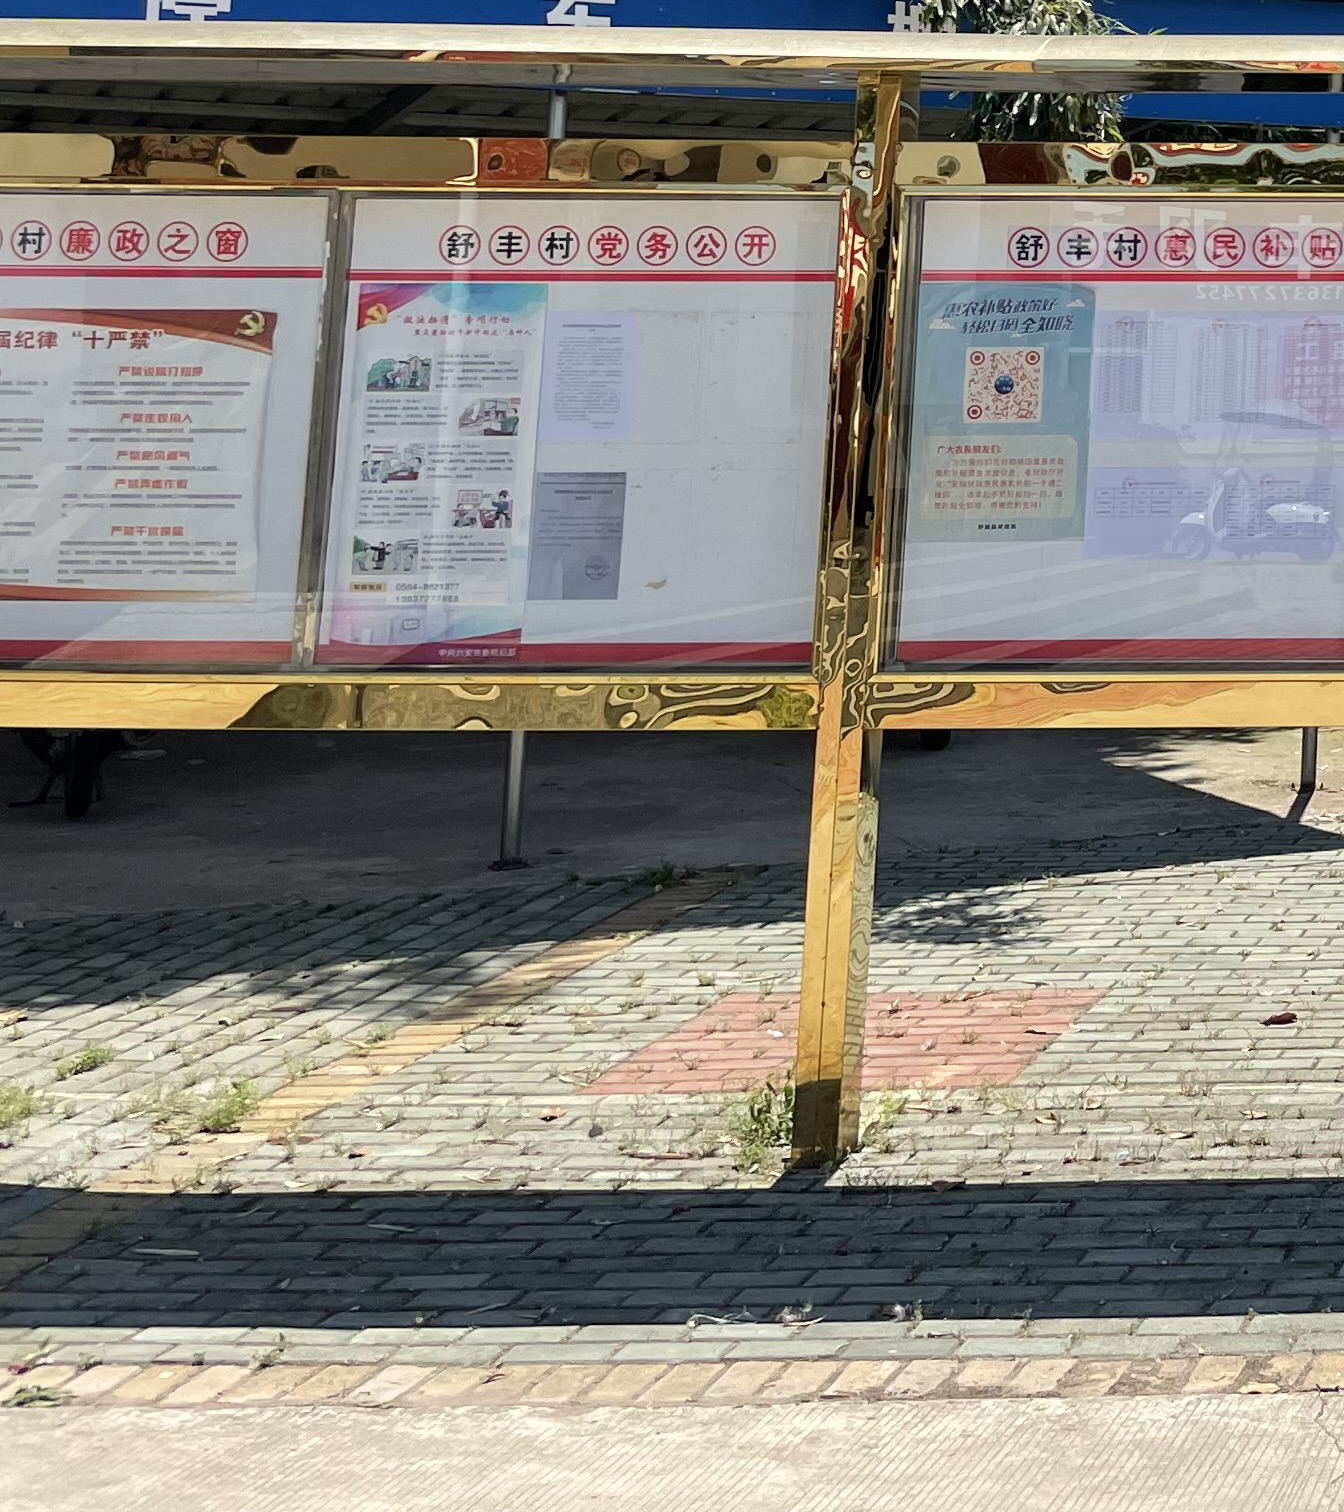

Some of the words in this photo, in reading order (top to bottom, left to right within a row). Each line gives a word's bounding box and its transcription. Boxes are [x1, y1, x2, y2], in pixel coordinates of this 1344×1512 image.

[17, 226, 243, 257] 村廉政之窗
[446, 231, 771, 264] 舒丰村党务公开
[1014, 232, 1341, 264] 舒丰村惠民补贴
